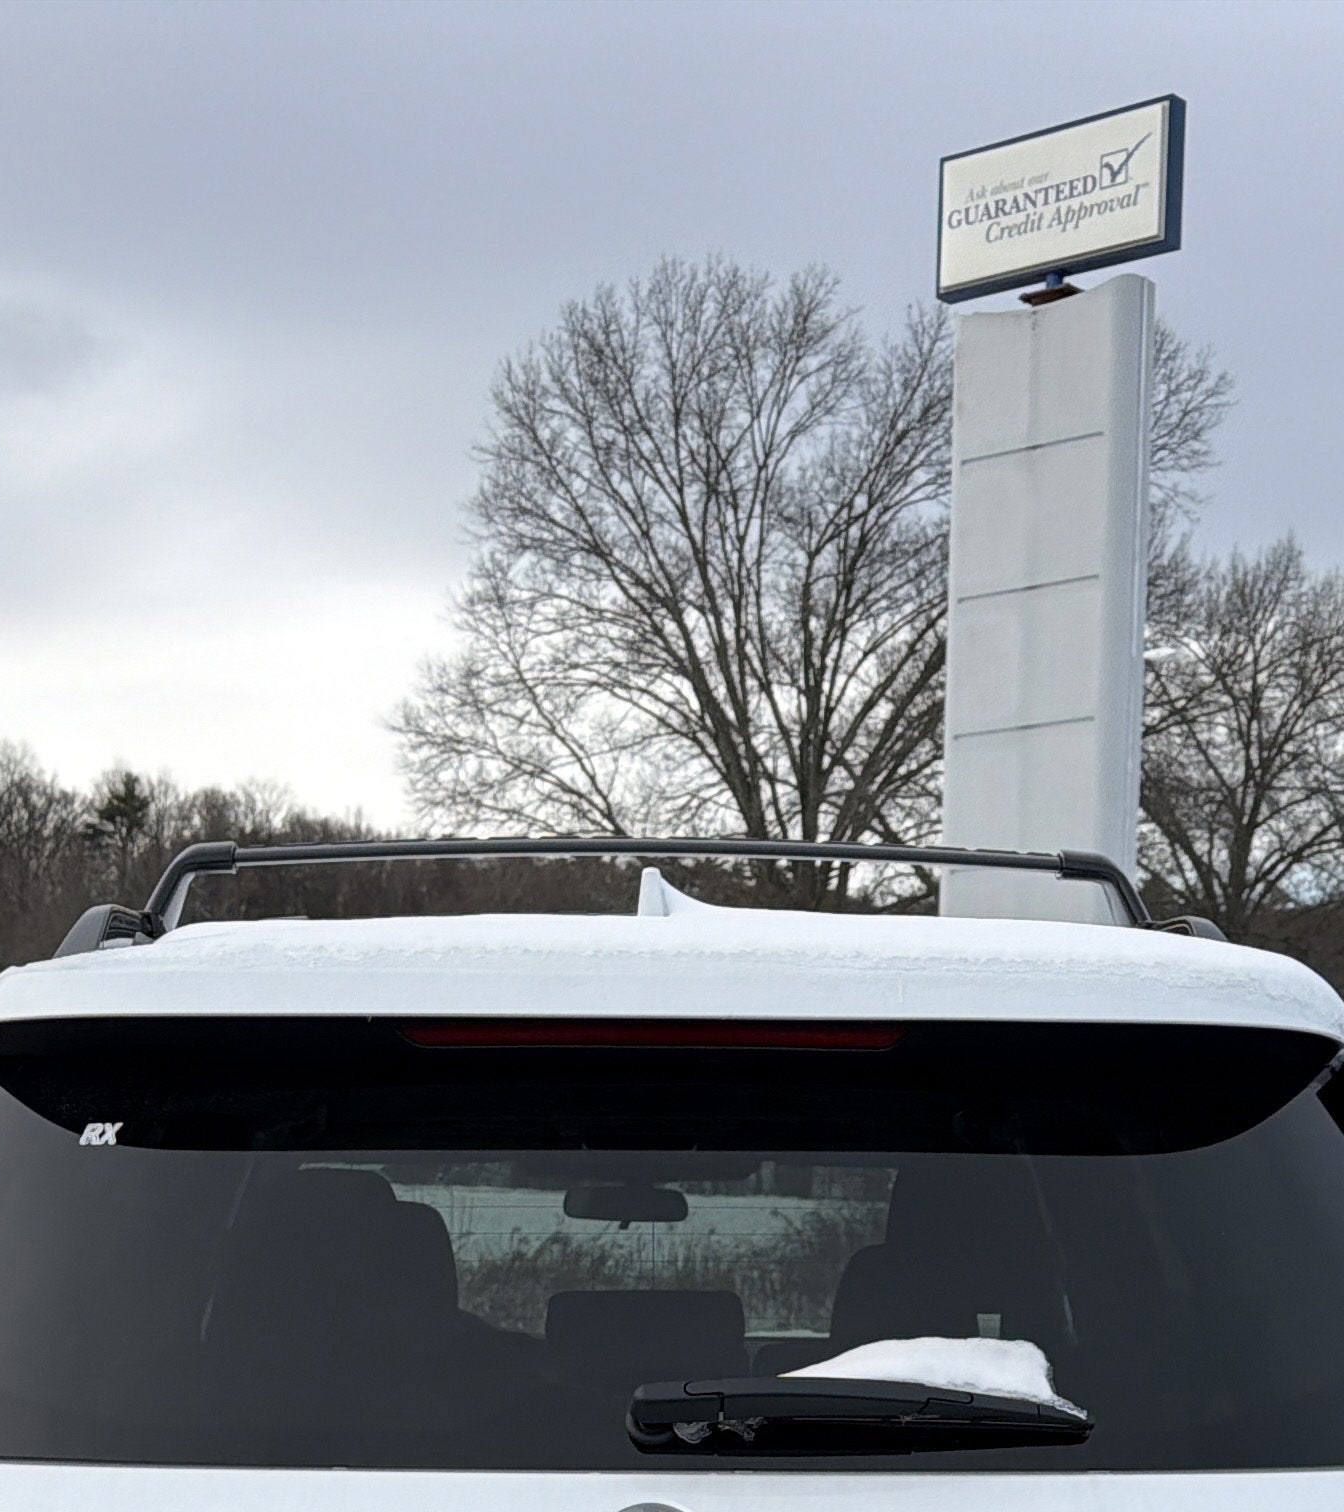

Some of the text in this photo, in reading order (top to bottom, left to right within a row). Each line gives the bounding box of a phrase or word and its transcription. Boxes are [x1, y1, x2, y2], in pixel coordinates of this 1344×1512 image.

[947, 174, 1097, 230] GUARANTEED
[985, 184, 1141, 243] Credit Approval
[79, 1122, 124, 1146] RX
